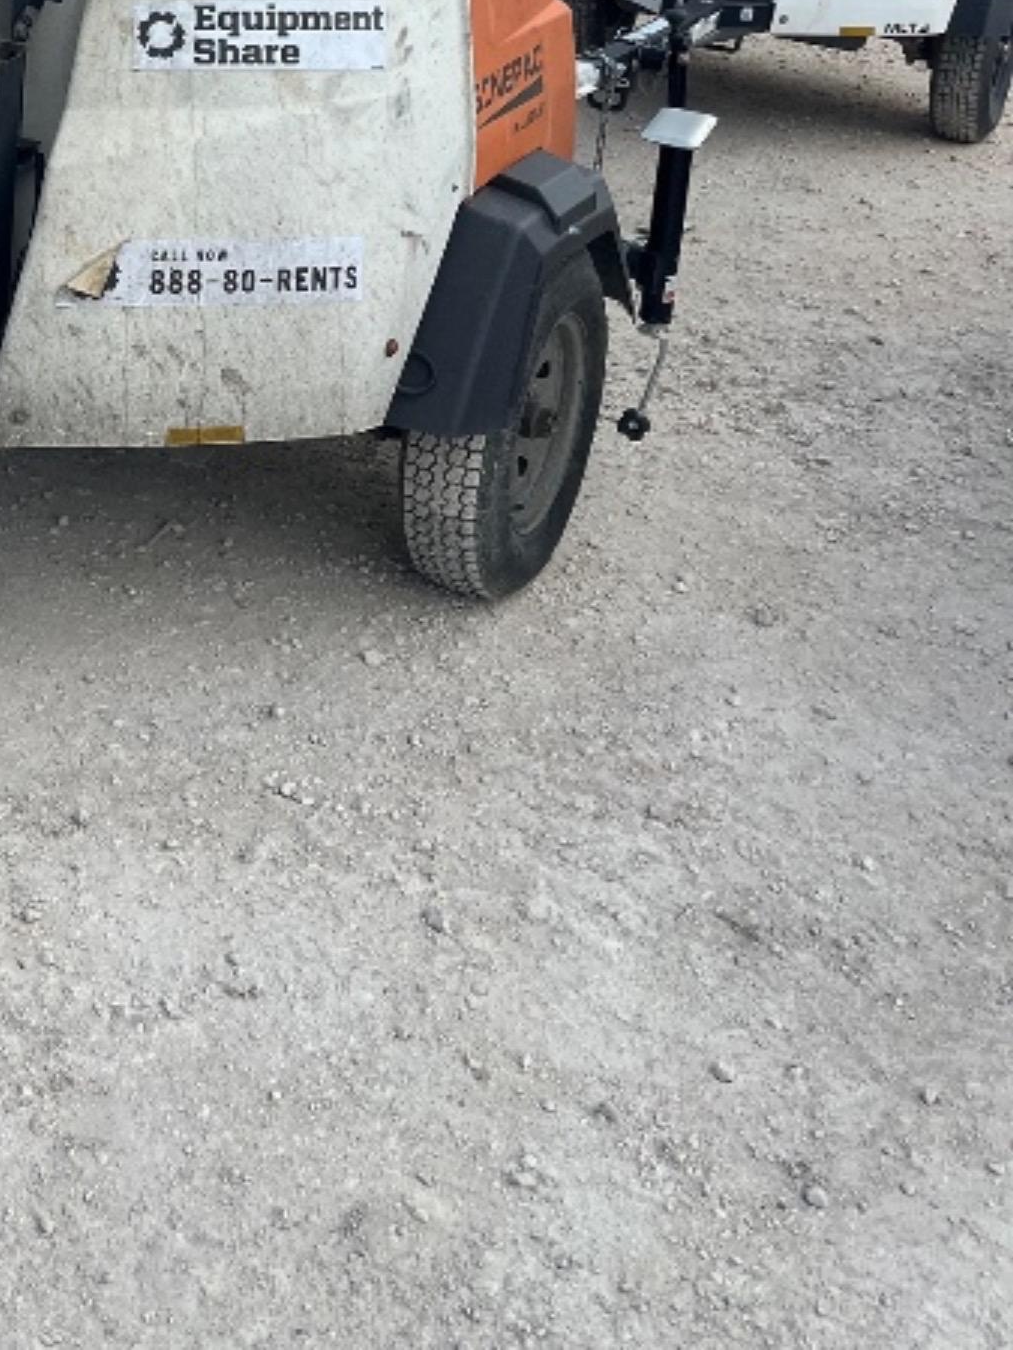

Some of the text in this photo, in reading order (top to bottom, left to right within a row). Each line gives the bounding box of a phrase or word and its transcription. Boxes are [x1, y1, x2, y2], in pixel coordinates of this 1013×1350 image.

[193, 3, 385, 37] Equipment
[193, 38, 300, 64] Share
[148, 264, 358, 296] 888-80-RENTS
